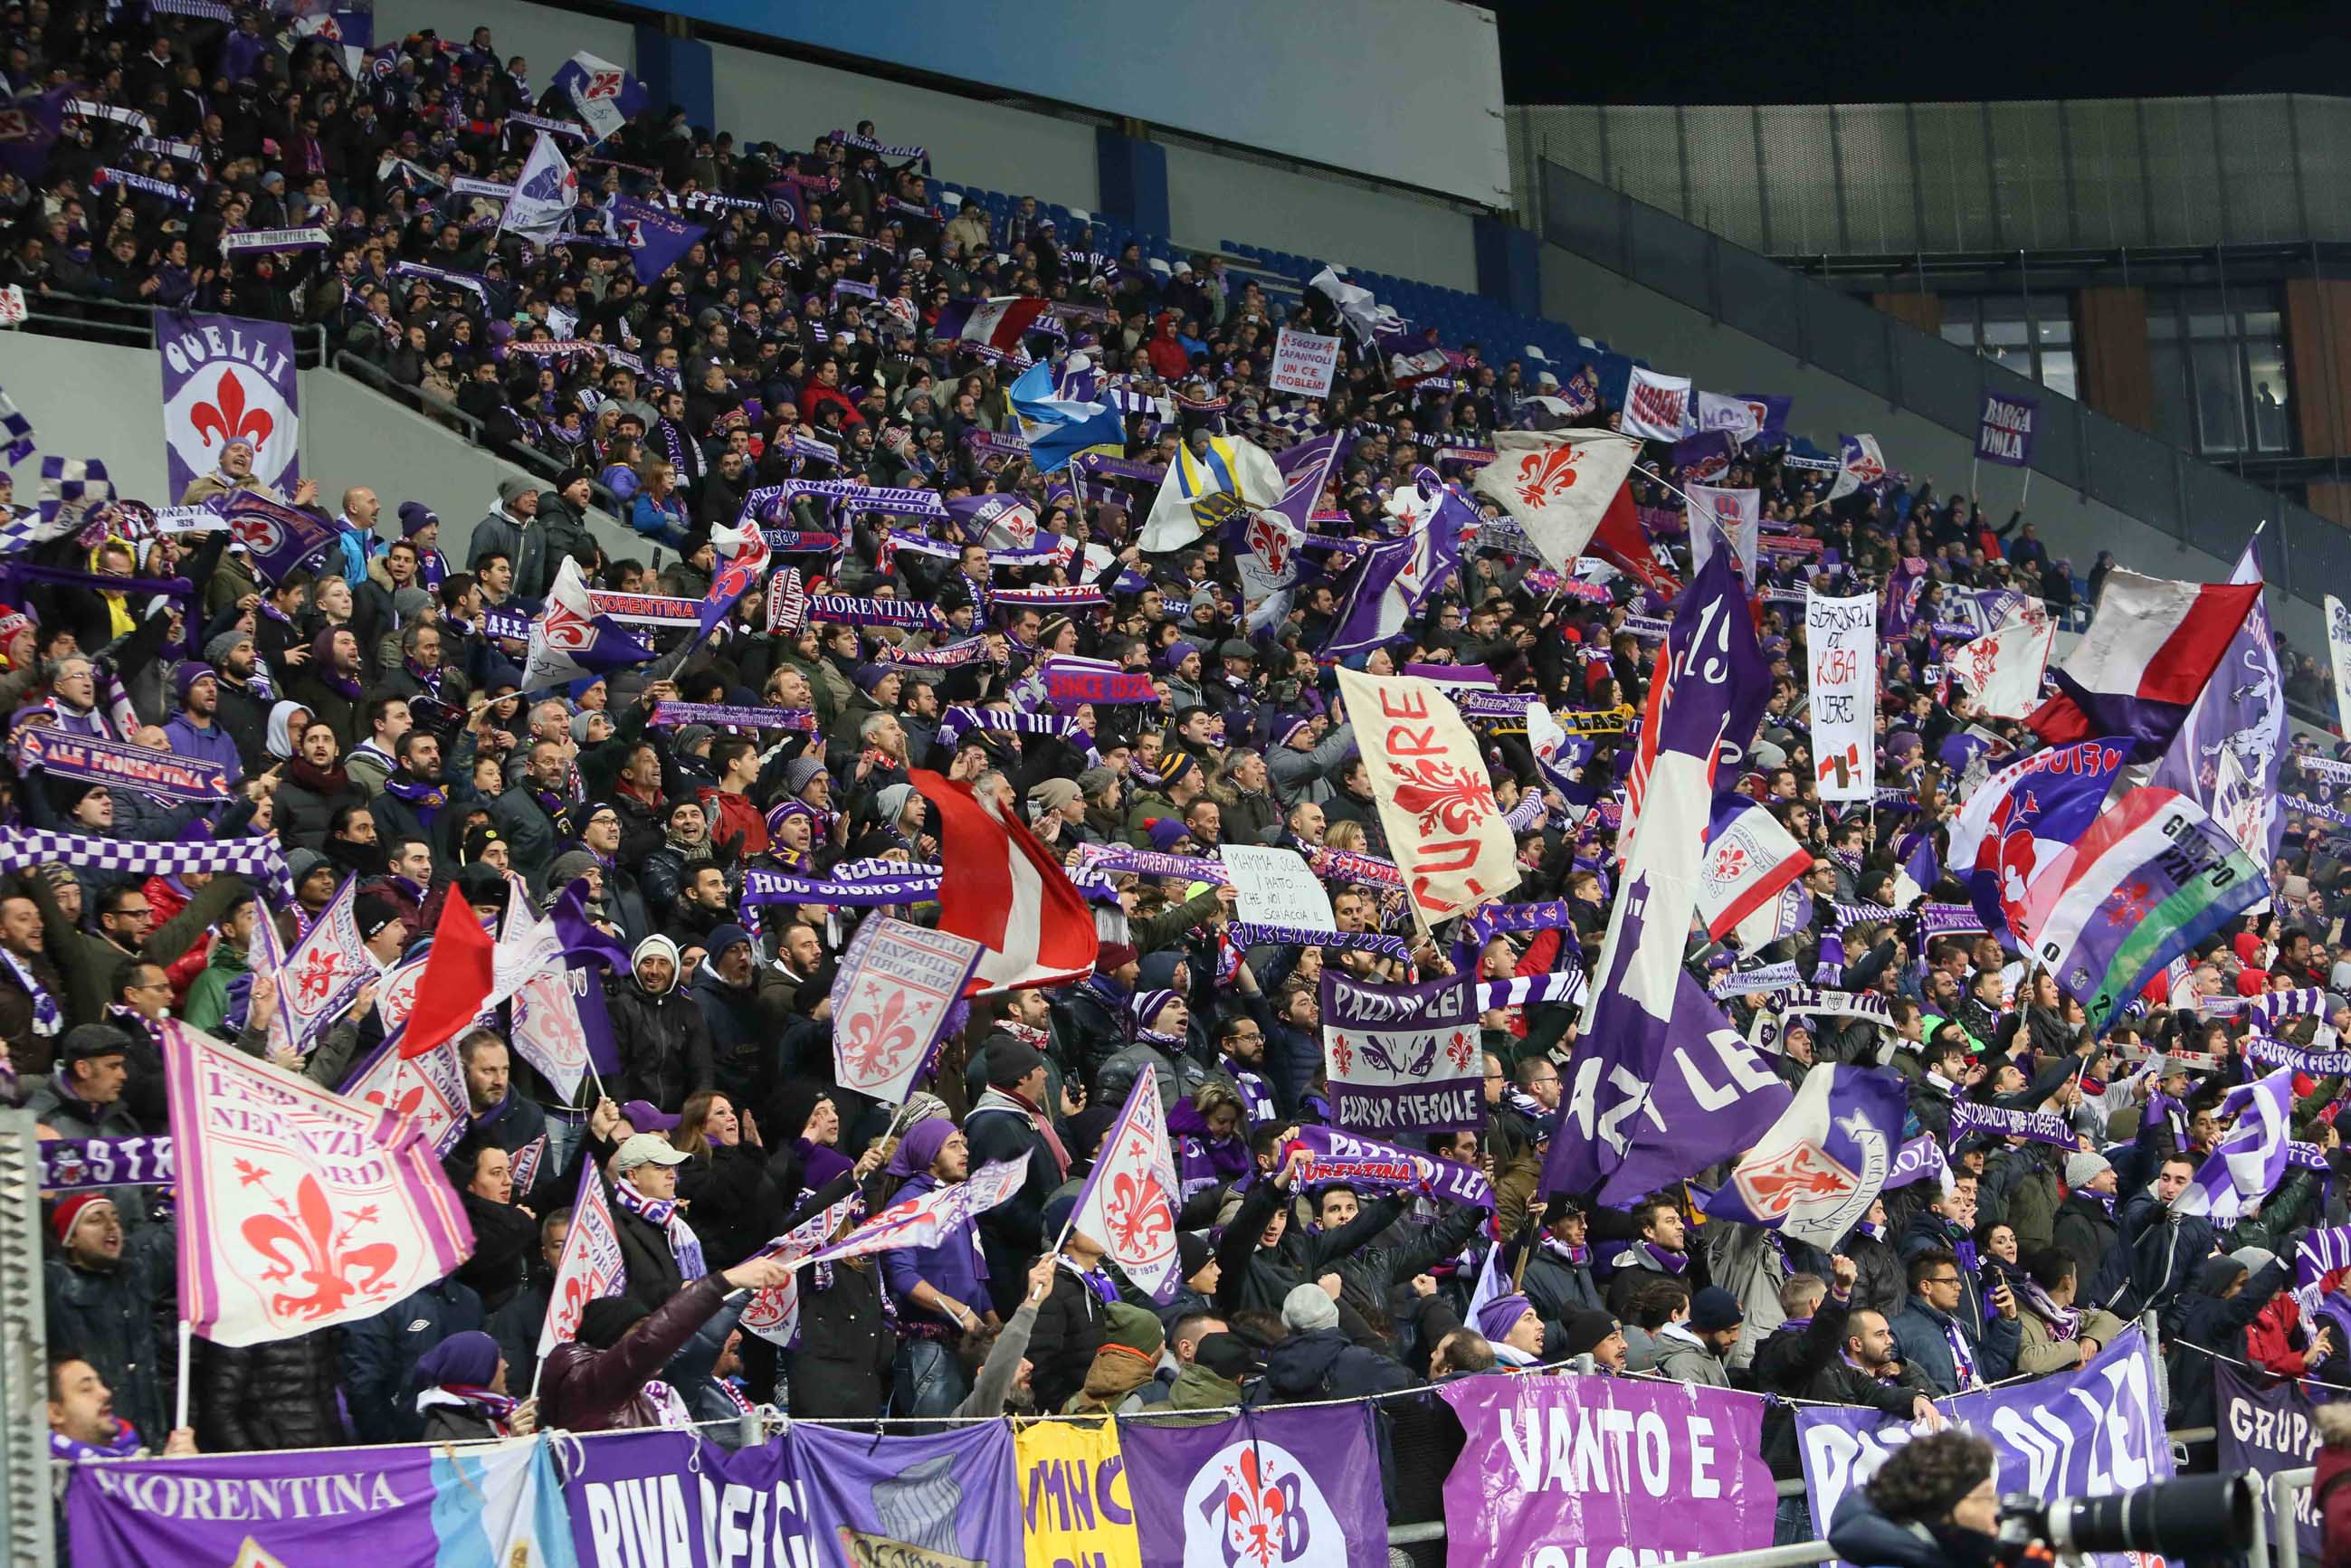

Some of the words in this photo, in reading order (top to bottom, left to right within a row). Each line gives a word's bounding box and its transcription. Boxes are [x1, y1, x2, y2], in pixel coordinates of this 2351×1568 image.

[166, 326, 288, 383] QUELLI
[1290, 337, 1322, 351] 56033
[1279, 349, 1331, 365] CAPANNOLI
[1282, 362, 1297, 374] UN
[1276, 375, 1326, 391] PROBLEMI
[1983, 397, 2032, 432] BARGA
[1981, 425, 2023, 460] VIOLA
[879, 487, 932, 502] VIOLA
[588, 594, 695, 619] FIORENTINA
[814, 595, 928, 620] FIORENTINA
[1827, 632, 1844, 650] DI
[1815, 650, 1857, 686] KUBA
[1050, 674, 1106, 698] SINCE
[47, 744, 85, 767] ALE
[91, 752, 205, 789] FIORENTINA
[2281, 794, 2329, 818] ULTRAS
[1132, 851, 1190, 876] FIORENTINA
[1230, 852, 1271, 870] MAMMA
[1243, 891, 1261, 906] CHE
[1334, 984, 1394, 1022] PAZZI
[1424, 984, 1464, 1019] LEI
[2260, 1039, 2306, 1070] CURVA
[2308, 1050, 2351, 1073] FIESO
[1339, 1093, 1394, 1127] CURVA
[1398, 1089, 1479, 1126] FIESOLE
[2229, 1395, 2326, 1462] GRUPP
[1499, 1406, 1671, 1498] VANTO
[1687, 1415, 1721, 1499] E
